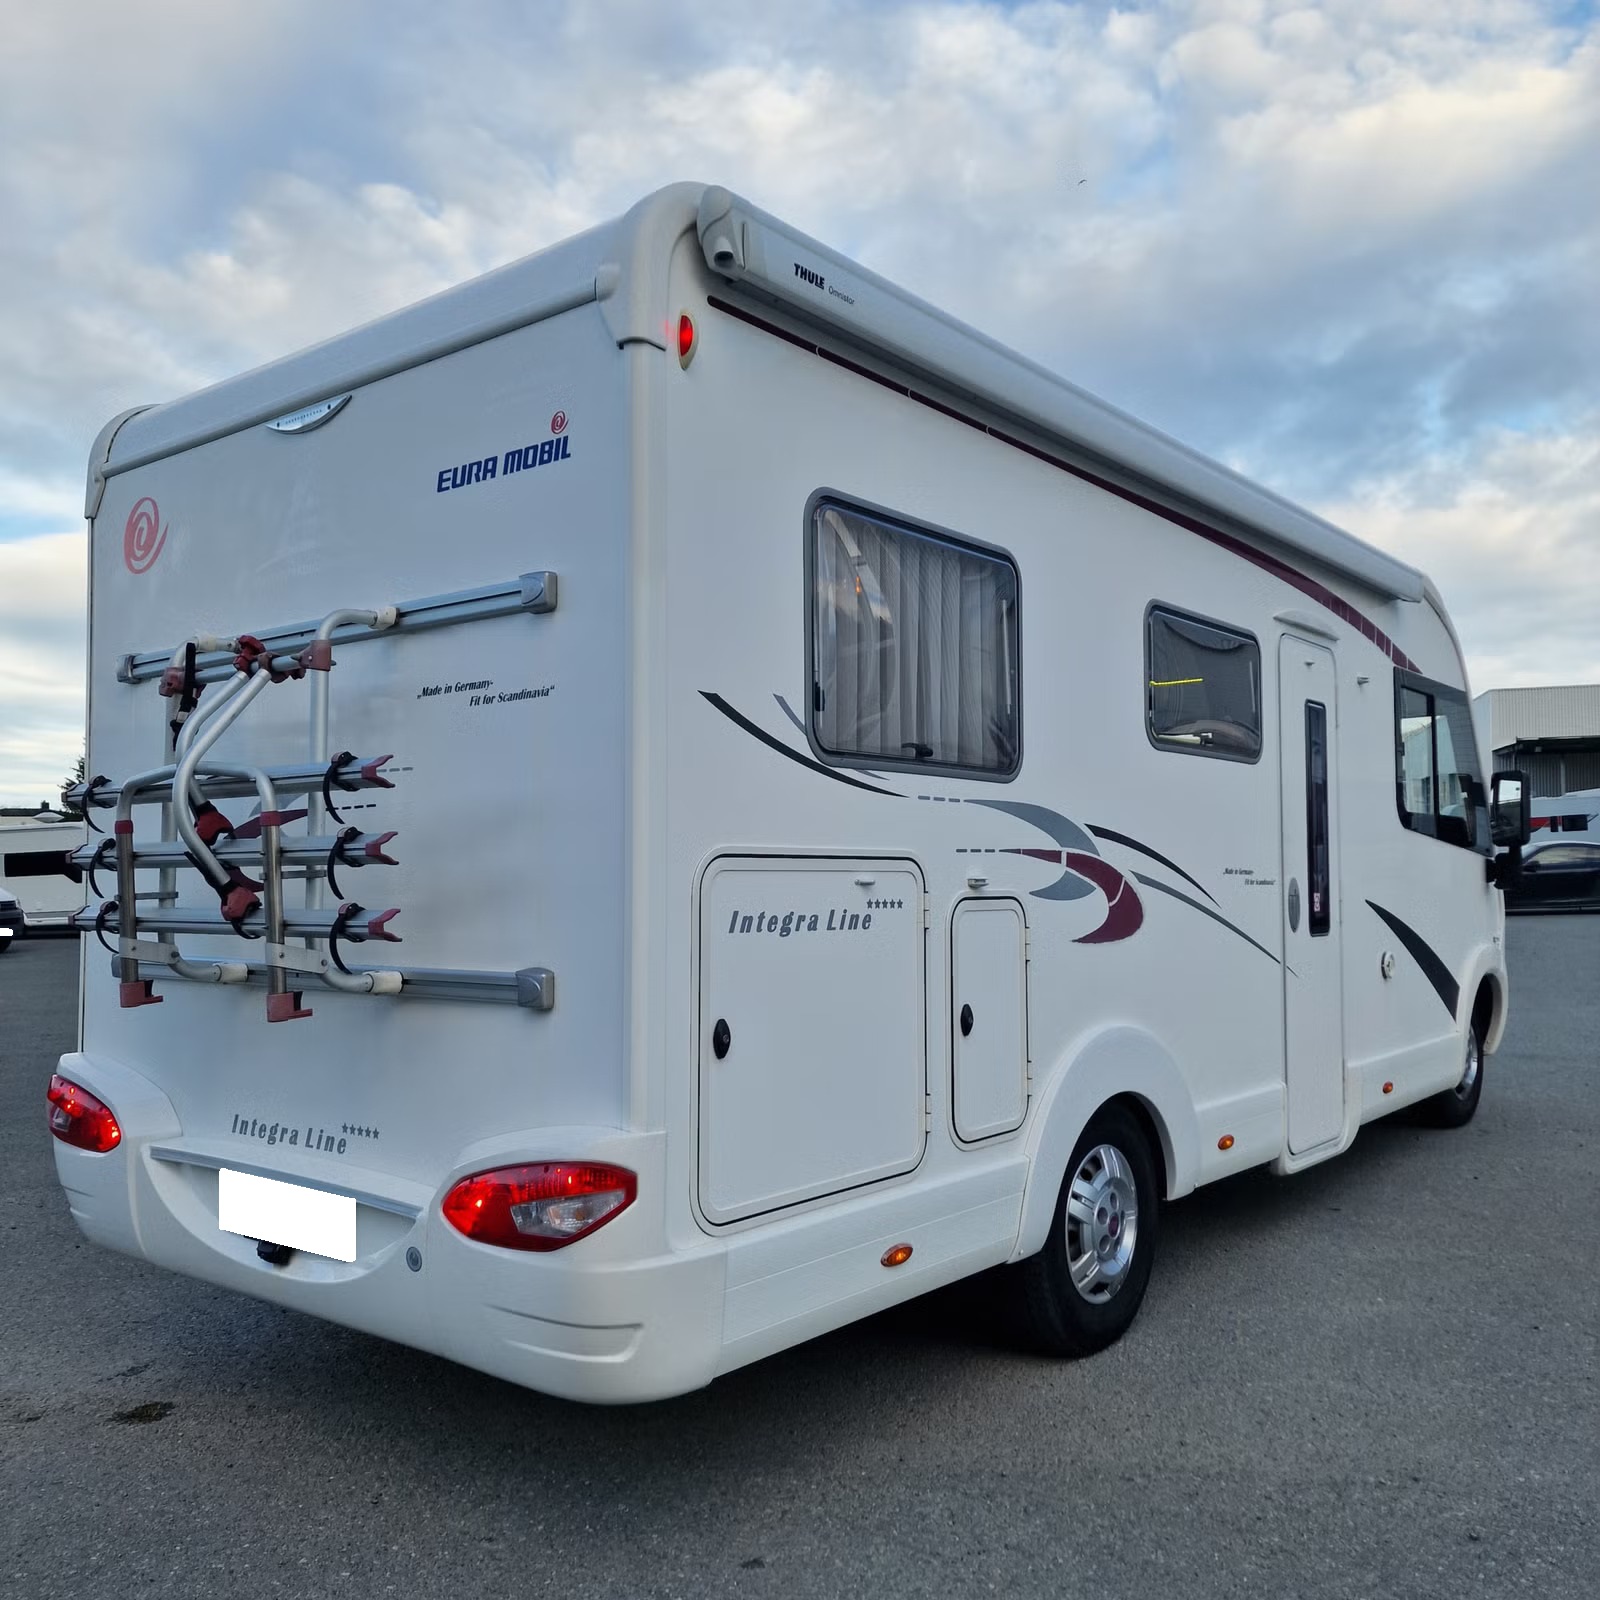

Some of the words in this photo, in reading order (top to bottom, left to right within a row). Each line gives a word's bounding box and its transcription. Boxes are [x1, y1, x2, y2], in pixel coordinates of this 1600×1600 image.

[794, 262, 825, 290] THULE
[437, 455, 498, 493] EURA
[502, 435, 571, 476] MOBIL
[444, 683, 453, 694] in
[469, 695, 481, 707] Fit
[482, 694, 496, 705] for
[728, 910, 819, 938] Integra
[826, 908, 872, 931] Line
[231, 1113, 299, 1145] Integra
[304, 1127, 347, 1155] Line
